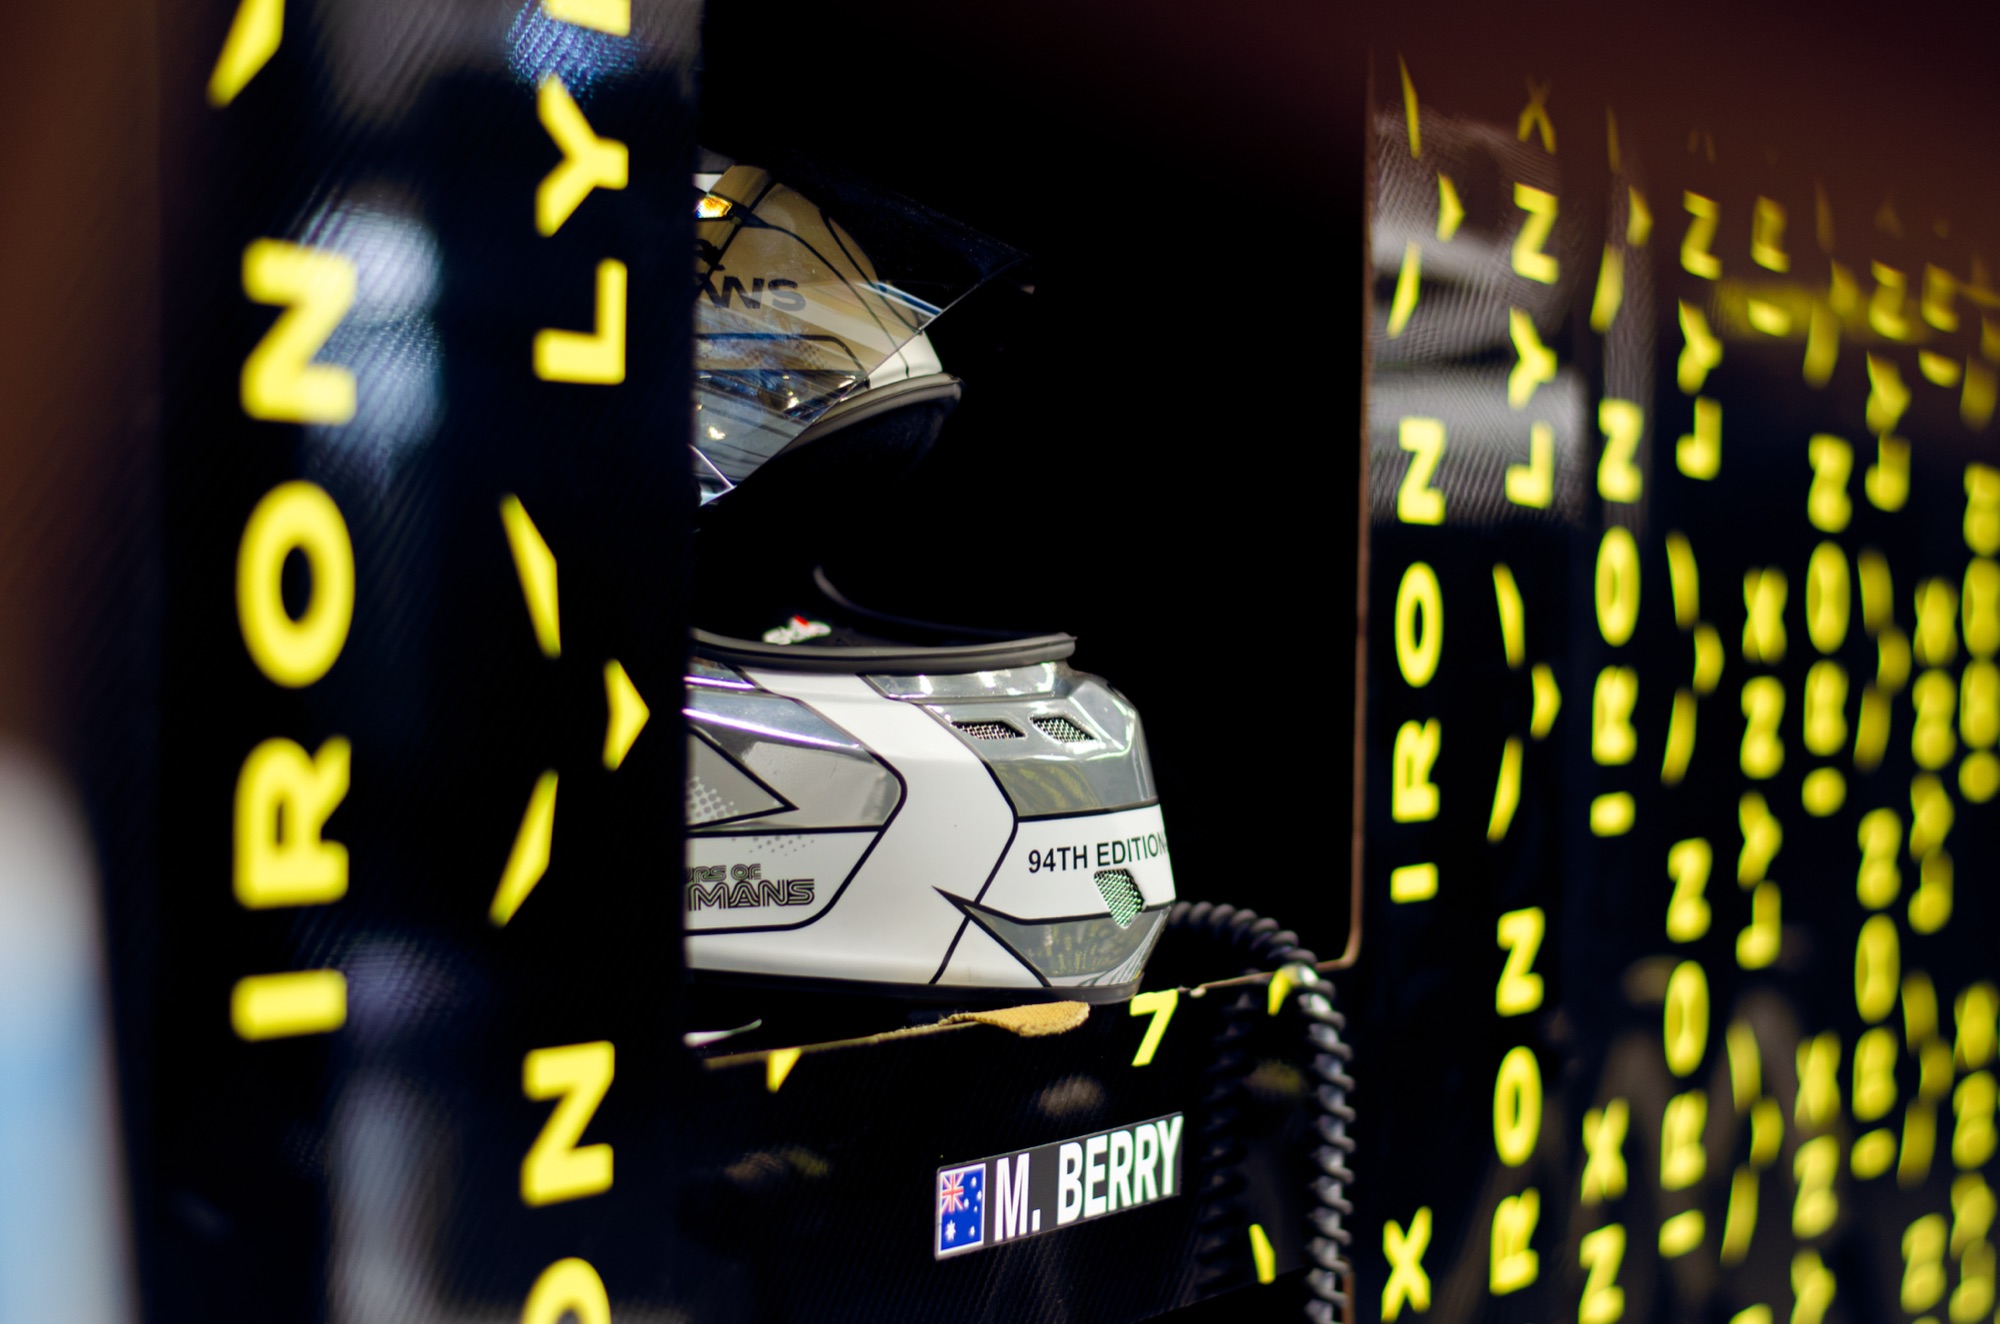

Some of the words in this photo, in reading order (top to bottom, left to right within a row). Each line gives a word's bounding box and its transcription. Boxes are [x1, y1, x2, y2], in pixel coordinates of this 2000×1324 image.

[534, 0, 631, 385] LY
[1505, 79, 1559, 509] LYNX
[232, 239, 355, 1040] IRON
[1390, 418, 1446, 904] IRON
[1589, 398, 1643, 837] IRON
[688, 878, 815, 912] MANS
[1028, 845, 1088, 874] 94TH
[1096, 831, 1167, 867] EDITION
[1658, 838, 1712, 1257] IRON
[993, 1152, 1041, 1242] M.
[1056, 1115, 1184, 1226] BERRY
